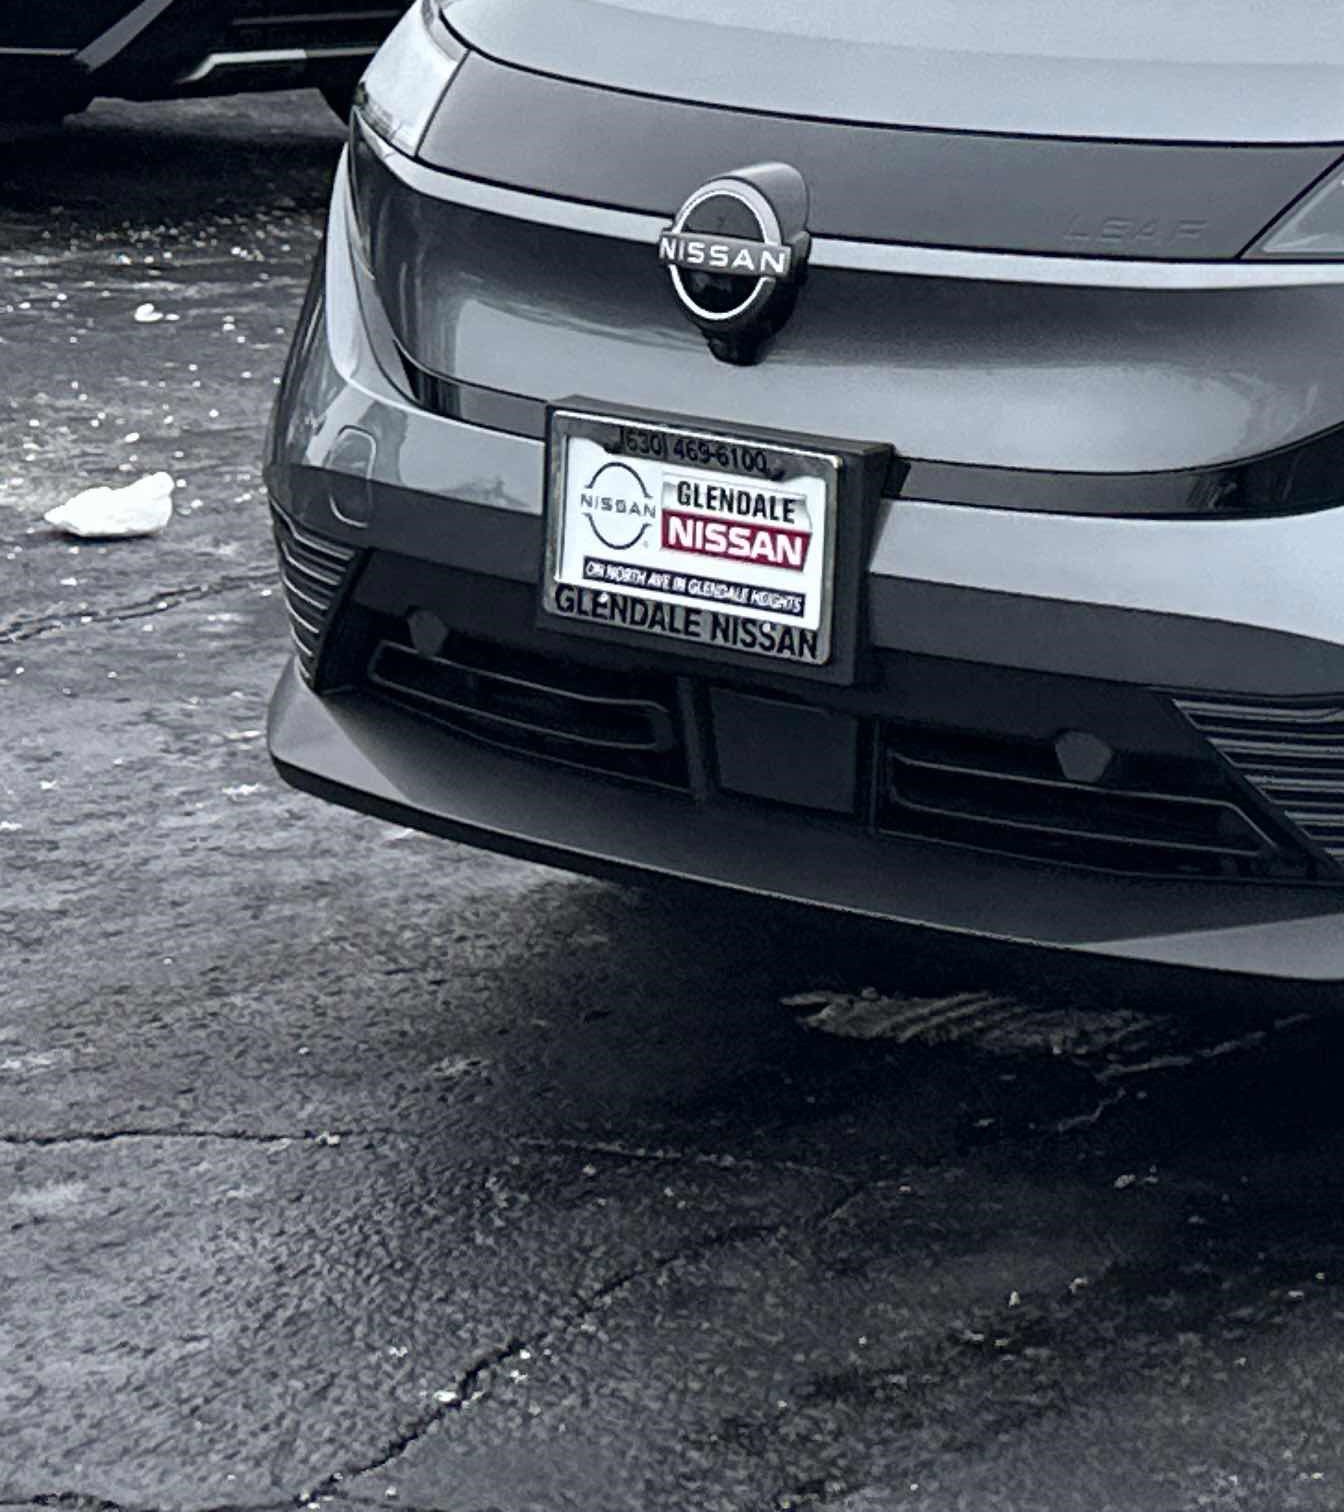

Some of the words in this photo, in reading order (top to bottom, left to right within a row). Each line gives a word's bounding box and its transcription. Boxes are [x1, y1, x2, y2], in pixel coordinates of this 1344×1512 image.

[659, 236, 786, 273] NISSAN
[673, 438, 769, 473] 469-6100
[580, 492, 656, 519] NISSAN
[677, 480, 796, 524] GLENDALE
[667, 520, 803, 567] NISSAN
[585, 561, 606, 577] ON
[606, 565, 646, 586] NORTH
[648, 573, 671, 590] AVE
[673, 576, 687, 592] IN
[688, 579, 750, 604] GLENDALE
[750, 591, 803, 613] HEIGHTS
[555, 585, 702, 637] GLENDALE
[711, 611, 819, 660] NISSAN
